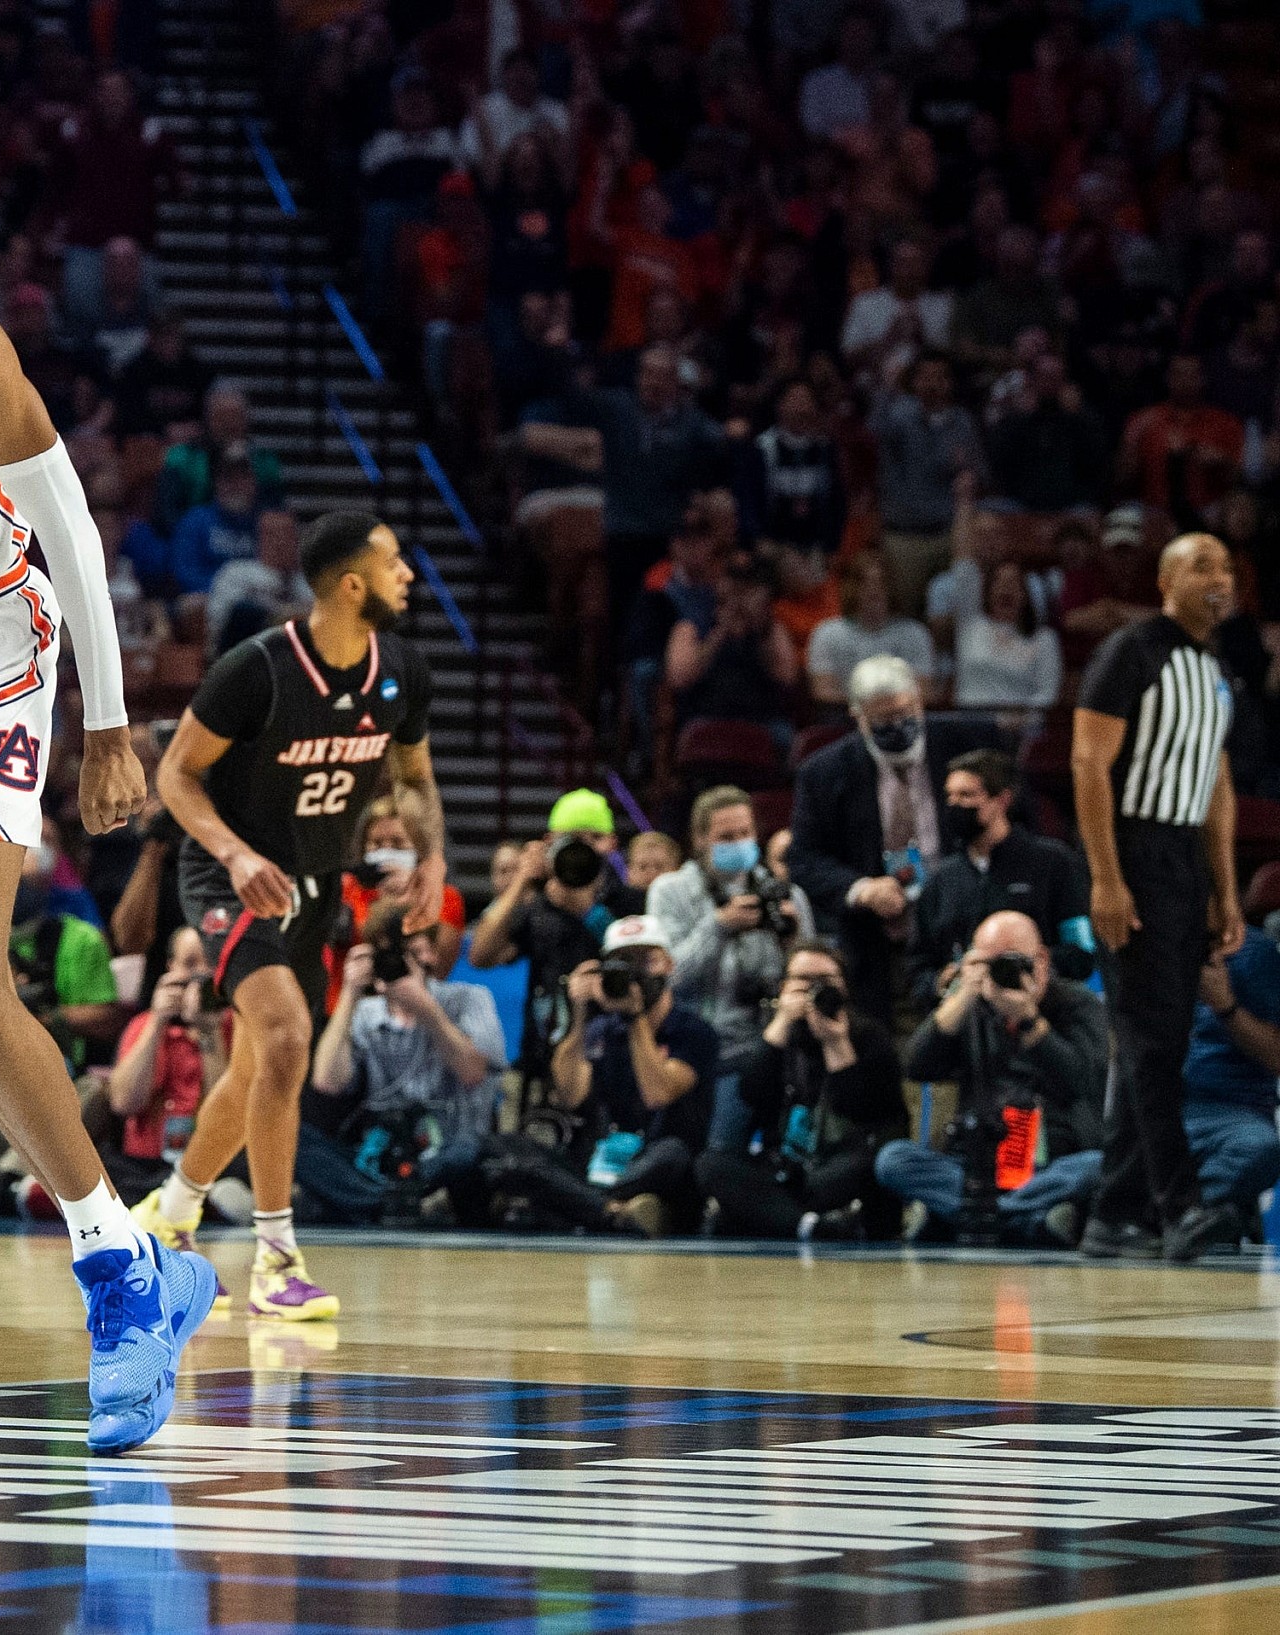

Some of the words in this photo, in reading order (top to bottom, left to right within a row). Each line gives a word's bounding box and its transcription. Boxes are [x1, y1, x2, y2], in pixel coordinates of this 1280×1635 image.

[277, 738, 330, 765] JAX
[328, 733, 391, 763] STATE
[295, 769, 355, 816] 22
